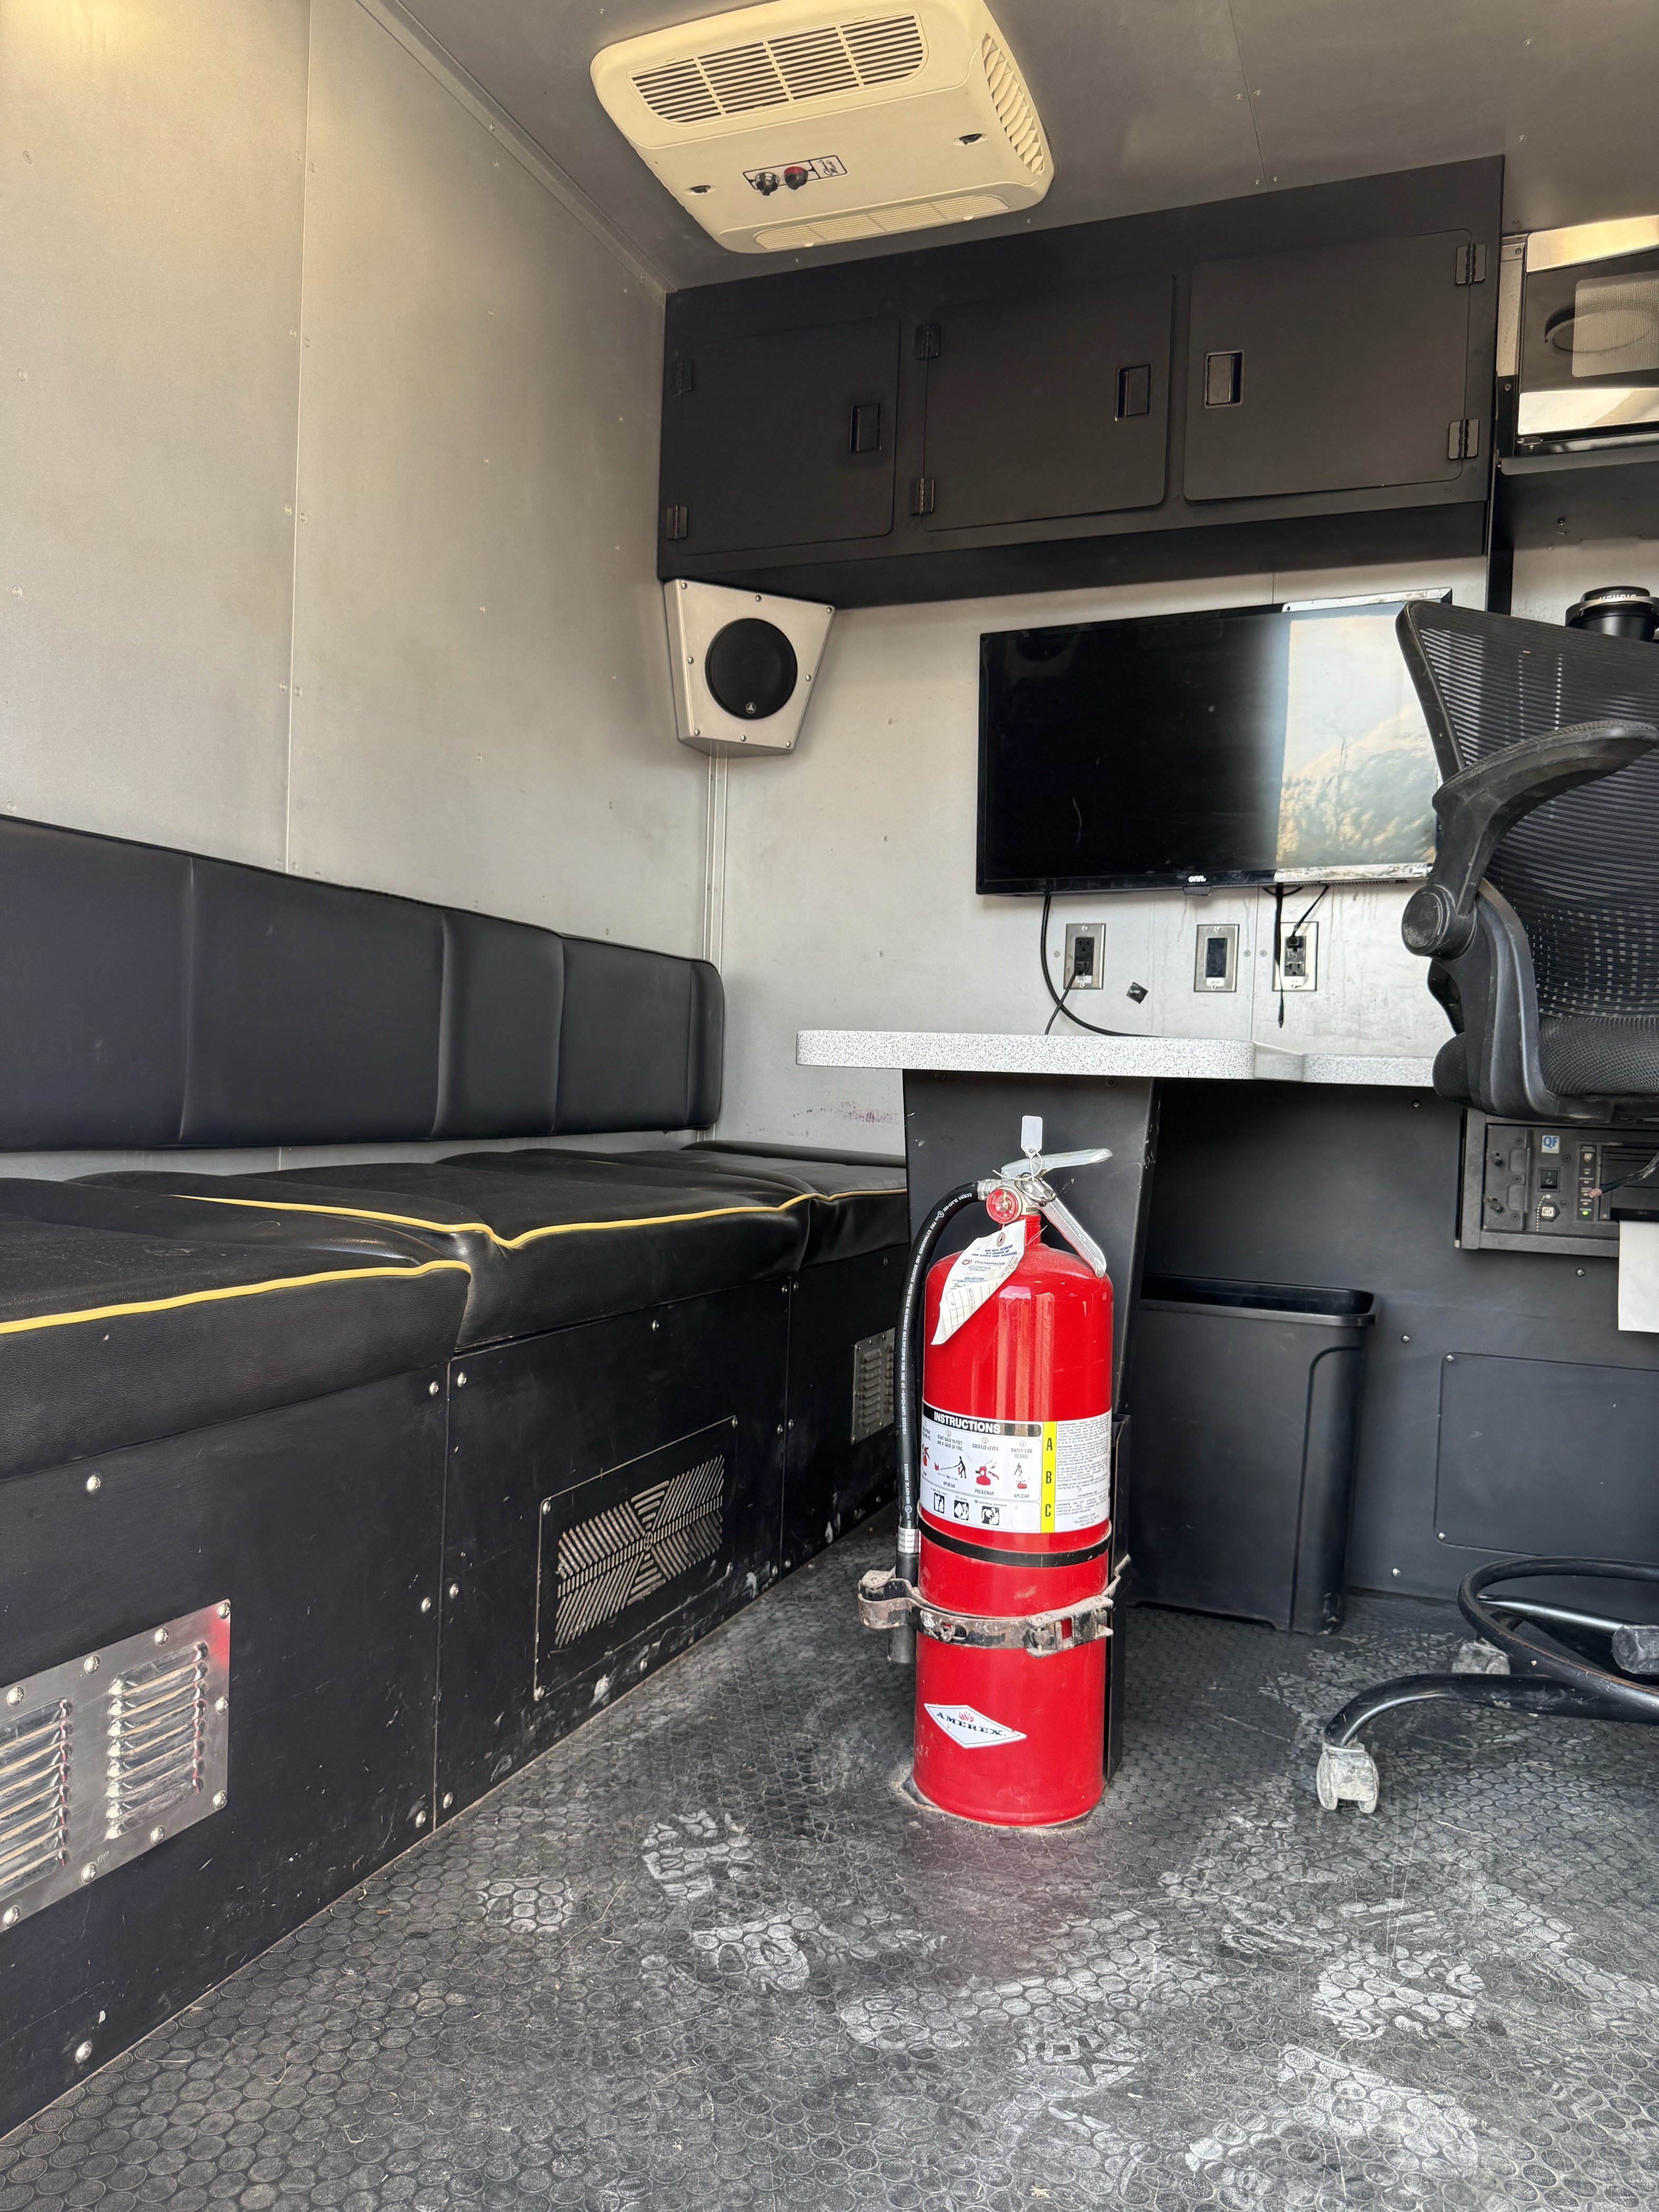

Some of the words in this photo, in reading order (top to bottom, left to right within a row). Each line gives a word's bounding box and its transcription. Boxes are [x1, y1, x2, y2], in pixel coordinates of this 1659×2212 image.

[1543, 1136, 1558, 1148] QF
[933, 1411, 1000, 1434] INSTRUCTIONS
[1046, 1437, 1053, 1451] A
[1045, 1471, 1052, 1484] B
[1045, 1503, 1051, 1517] C
[936, 1712, 1004, 1736] AMEREX
